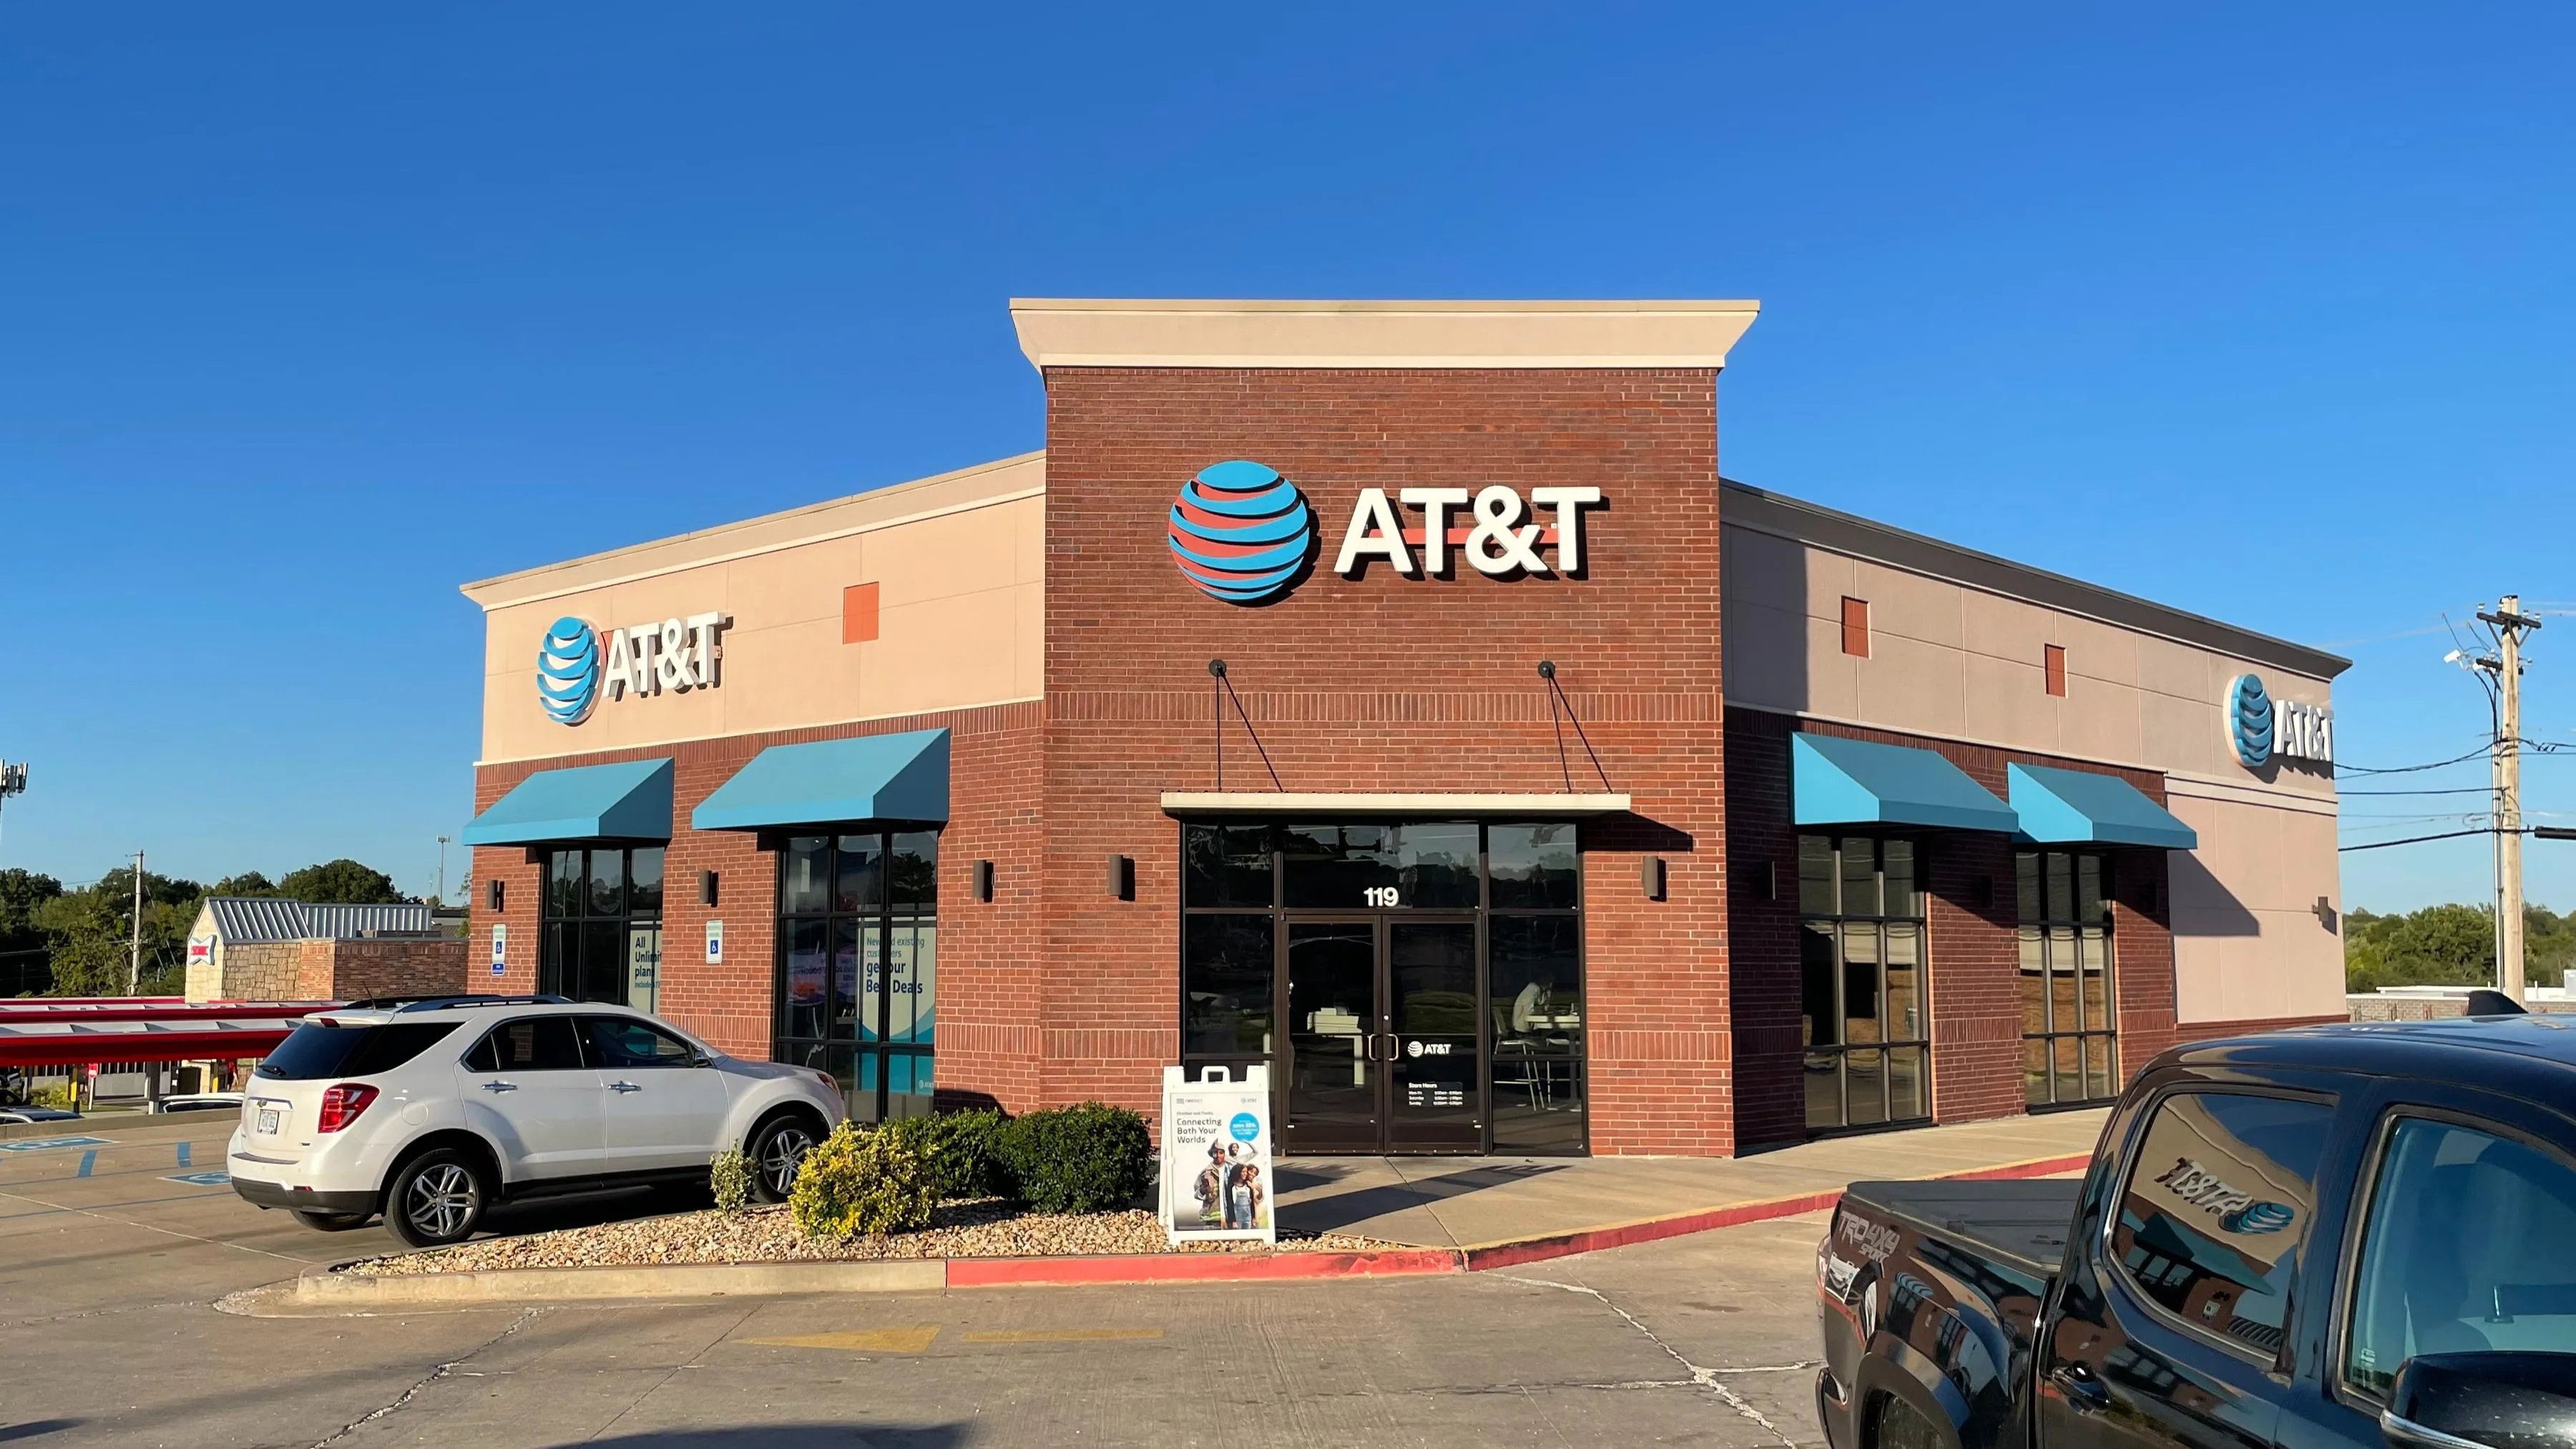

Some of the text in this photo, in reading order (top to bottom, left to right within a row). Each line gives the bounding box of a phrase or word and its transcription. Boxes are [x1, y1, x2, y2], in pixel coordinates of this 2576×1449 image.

[1333, 484, 1601, 574] AT&T
[602, 611, 725, 697] AT&T
[2273, 699, 2335, 762] AT&T
[1363, 887, 1399, 907] 119
[635, 936, 646, 948] All
[893, 978, 923, 993] Deals
[1424, 1044, 1451, 1054] AT&T
[1177, 1118, 1222, 1126] Connecting
[1839, 1209, 1870, 1245] TRD
[1858, 1243, 1890, 1263] SPORT
